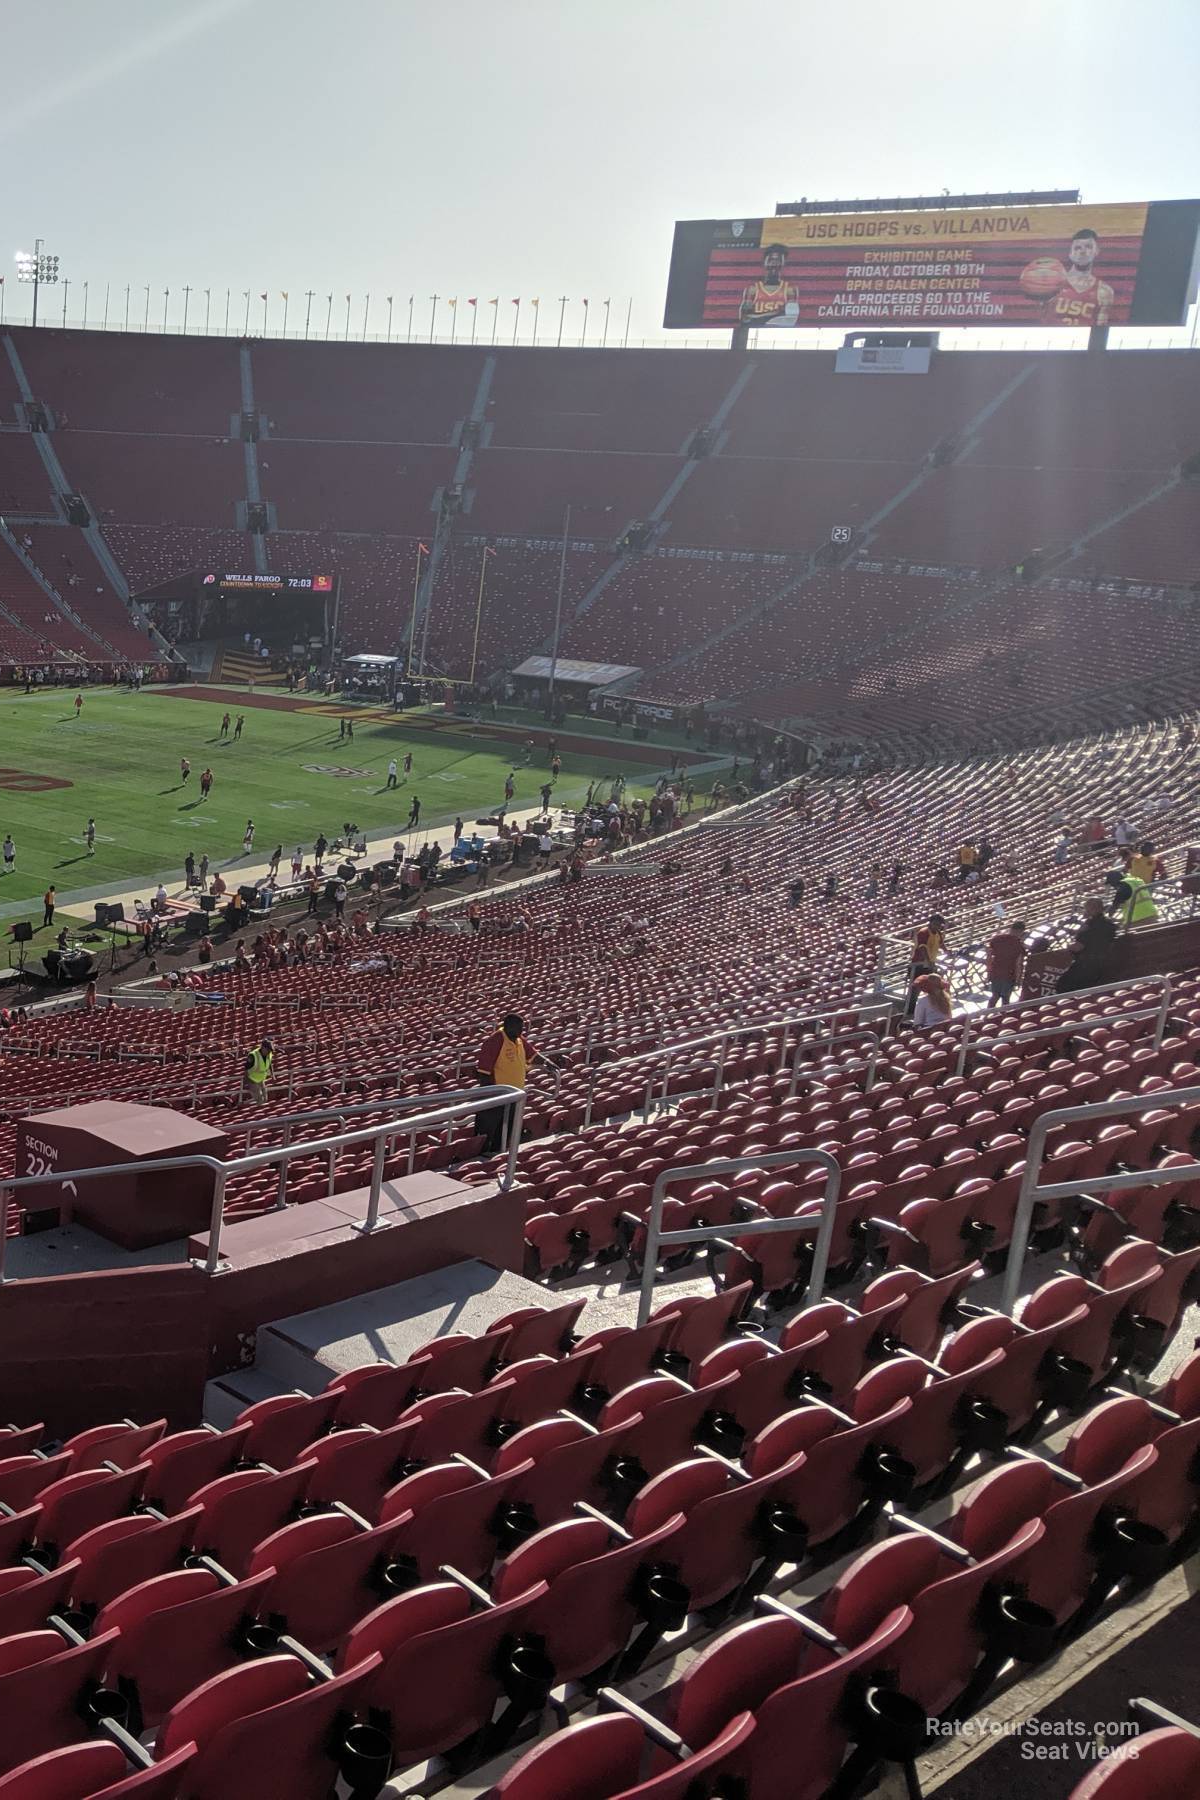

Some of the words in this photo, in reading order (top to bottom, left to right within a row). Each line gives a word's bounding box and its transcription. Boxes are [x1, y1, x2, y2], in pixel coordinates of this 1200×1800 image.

[805, 223, 838, 238] USC
[842, 221, 899, 237] HOOPS
[932, 217, 1031, 235] VILLANOVA
[864, 251, 934, 263] EXHIBITION
[936, 250, 973, 261] GAME
[846, 265, 890, 277] FRIDAY,
[893, 264, 951, 276] OCTOBER
[955, 263, 985, 275] 18TH
[886, 279, 927, 290] GALEN
[929, 278, 980, 289] CENTER
[832, 294, 855, 305] ALL
[858, 293, 922, 304] PROCEEDS
[926, 293, 942, 303] GO
[947, 293, 963, 303] TO
[967, 292, 991, 303] THE
[818, 306, 889, 317] CALIFORNIA
[893, 305, 920, 316] FIRE
[923, 304, 1004, 315] FOUNDATION
[1055, 297, 1097, 318] USC
[834, 528, 848, 540] 25
[288, 579, 311, 588] 72:03
[25, 1134, 58, 1160] SECTION
